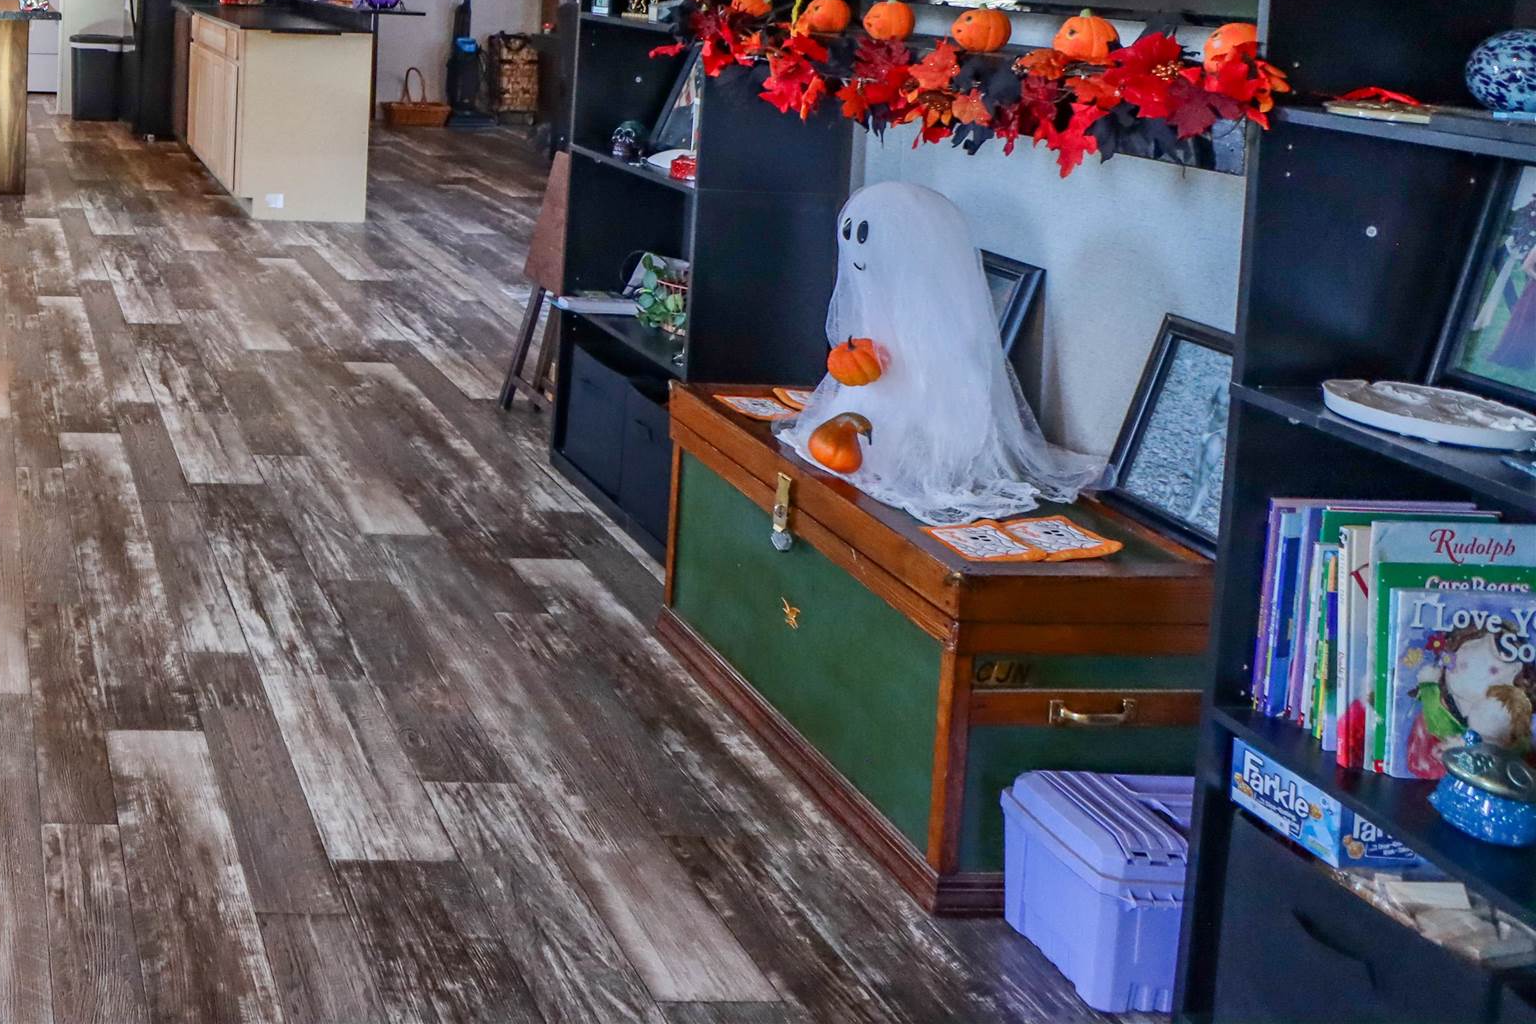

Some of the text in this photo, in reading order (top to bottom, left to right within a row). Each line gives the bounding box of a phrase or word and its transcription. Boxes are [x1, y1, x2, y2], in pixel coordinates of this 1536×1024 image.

[1429, 528, 1516, 564] Rudolph
[1431, 602, 1503, 634] Love
[1243, 749, 1311, 819] Farkle
